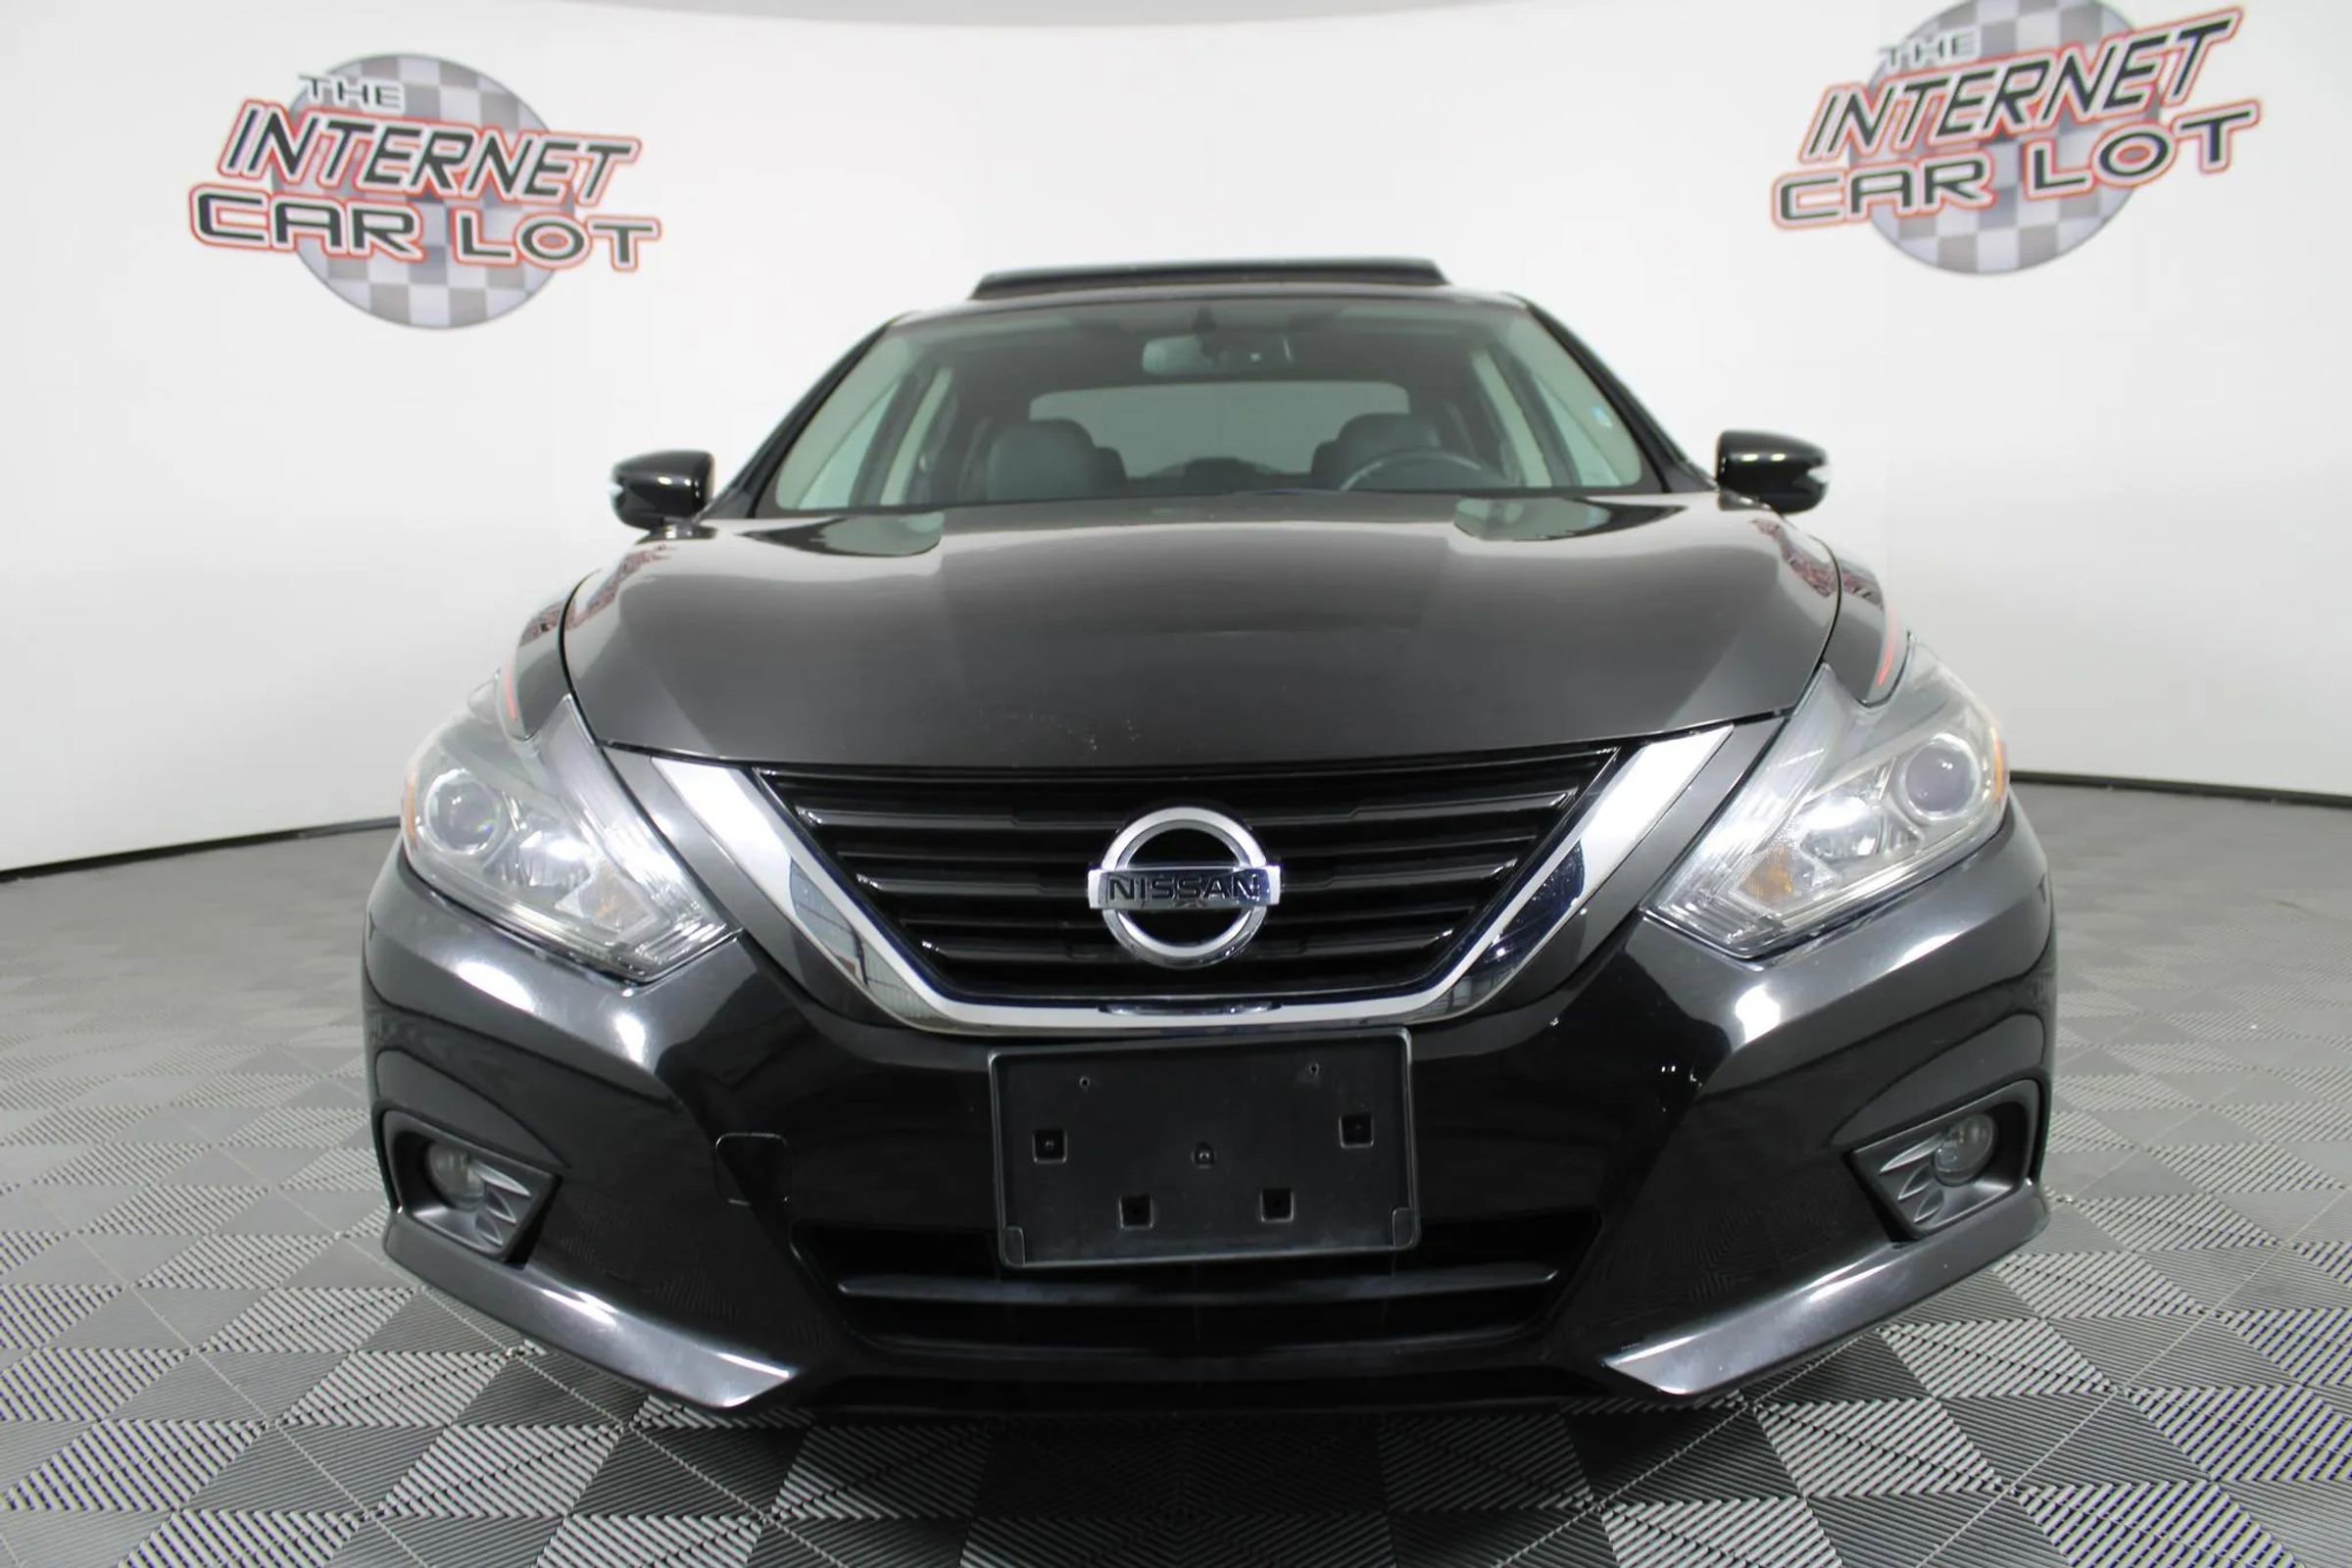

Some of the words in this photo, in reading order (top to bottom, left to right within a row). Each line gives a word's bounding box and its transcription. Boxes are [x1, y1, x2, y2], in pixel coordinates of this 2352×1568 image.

[1803, 12, 2238, 159] INTERNET
[1879, 29, 1981, 70] THE
[299, 74, 406, 112] THE
[220, 102, 638, 204] INTERNET
[1775, 155, 1991, 225] CAR
[2025, 105, 2257, 196] LOT
[192, 186, 422, 258] CAR
[455, 208, 658, 267] LOT
[1108, 875, 1260, 901] NISSAN
